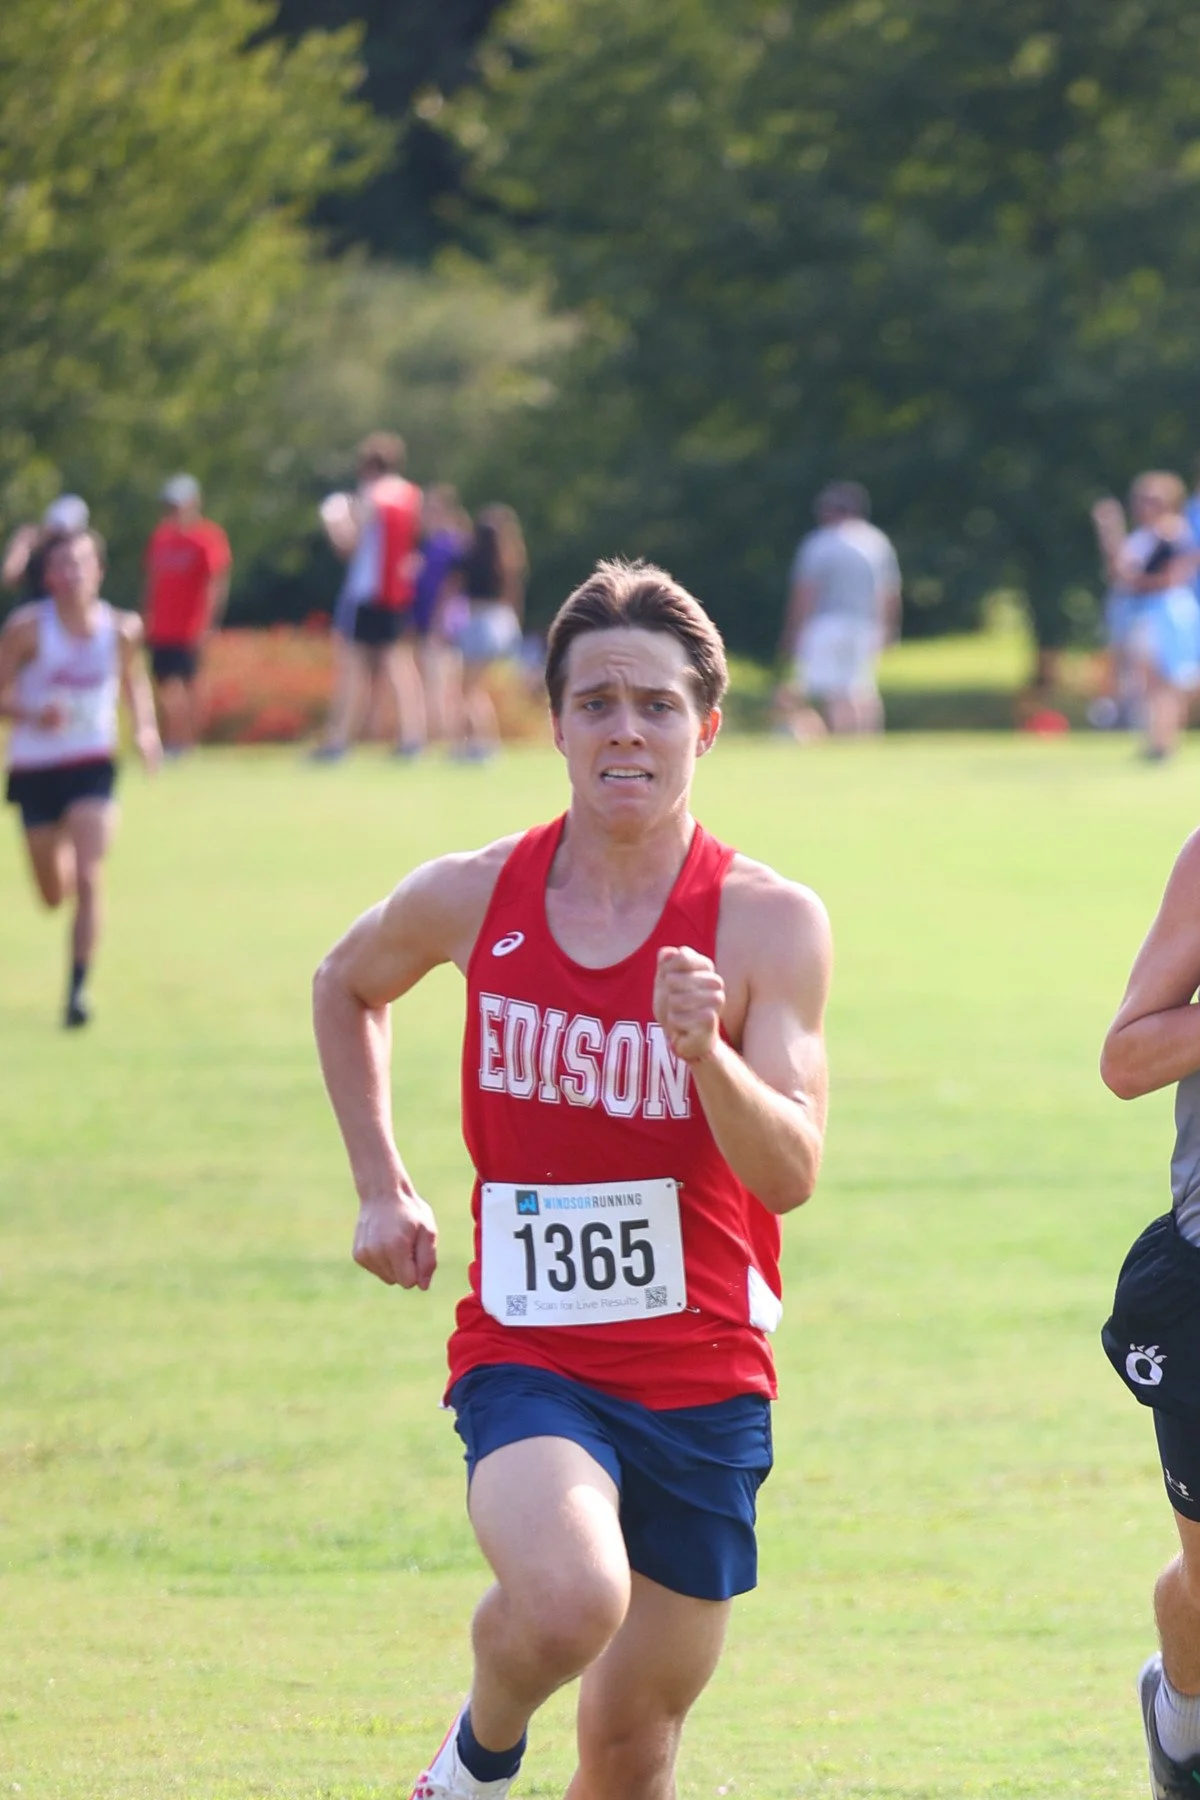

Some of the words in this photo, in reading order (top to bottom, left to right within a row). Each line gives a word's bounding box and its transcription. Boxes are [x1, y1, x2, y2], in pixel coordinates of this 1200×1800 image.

[479, 992, 691, 1120] EDISON
[513, 1219, 655, 1292] 1365
[534, 1300, 558, 1311] Scan
[560, 1299, 573, 1310] for
[576, 1299, 599, 1310] Live
[601, 1296, 640, 1307] Results
